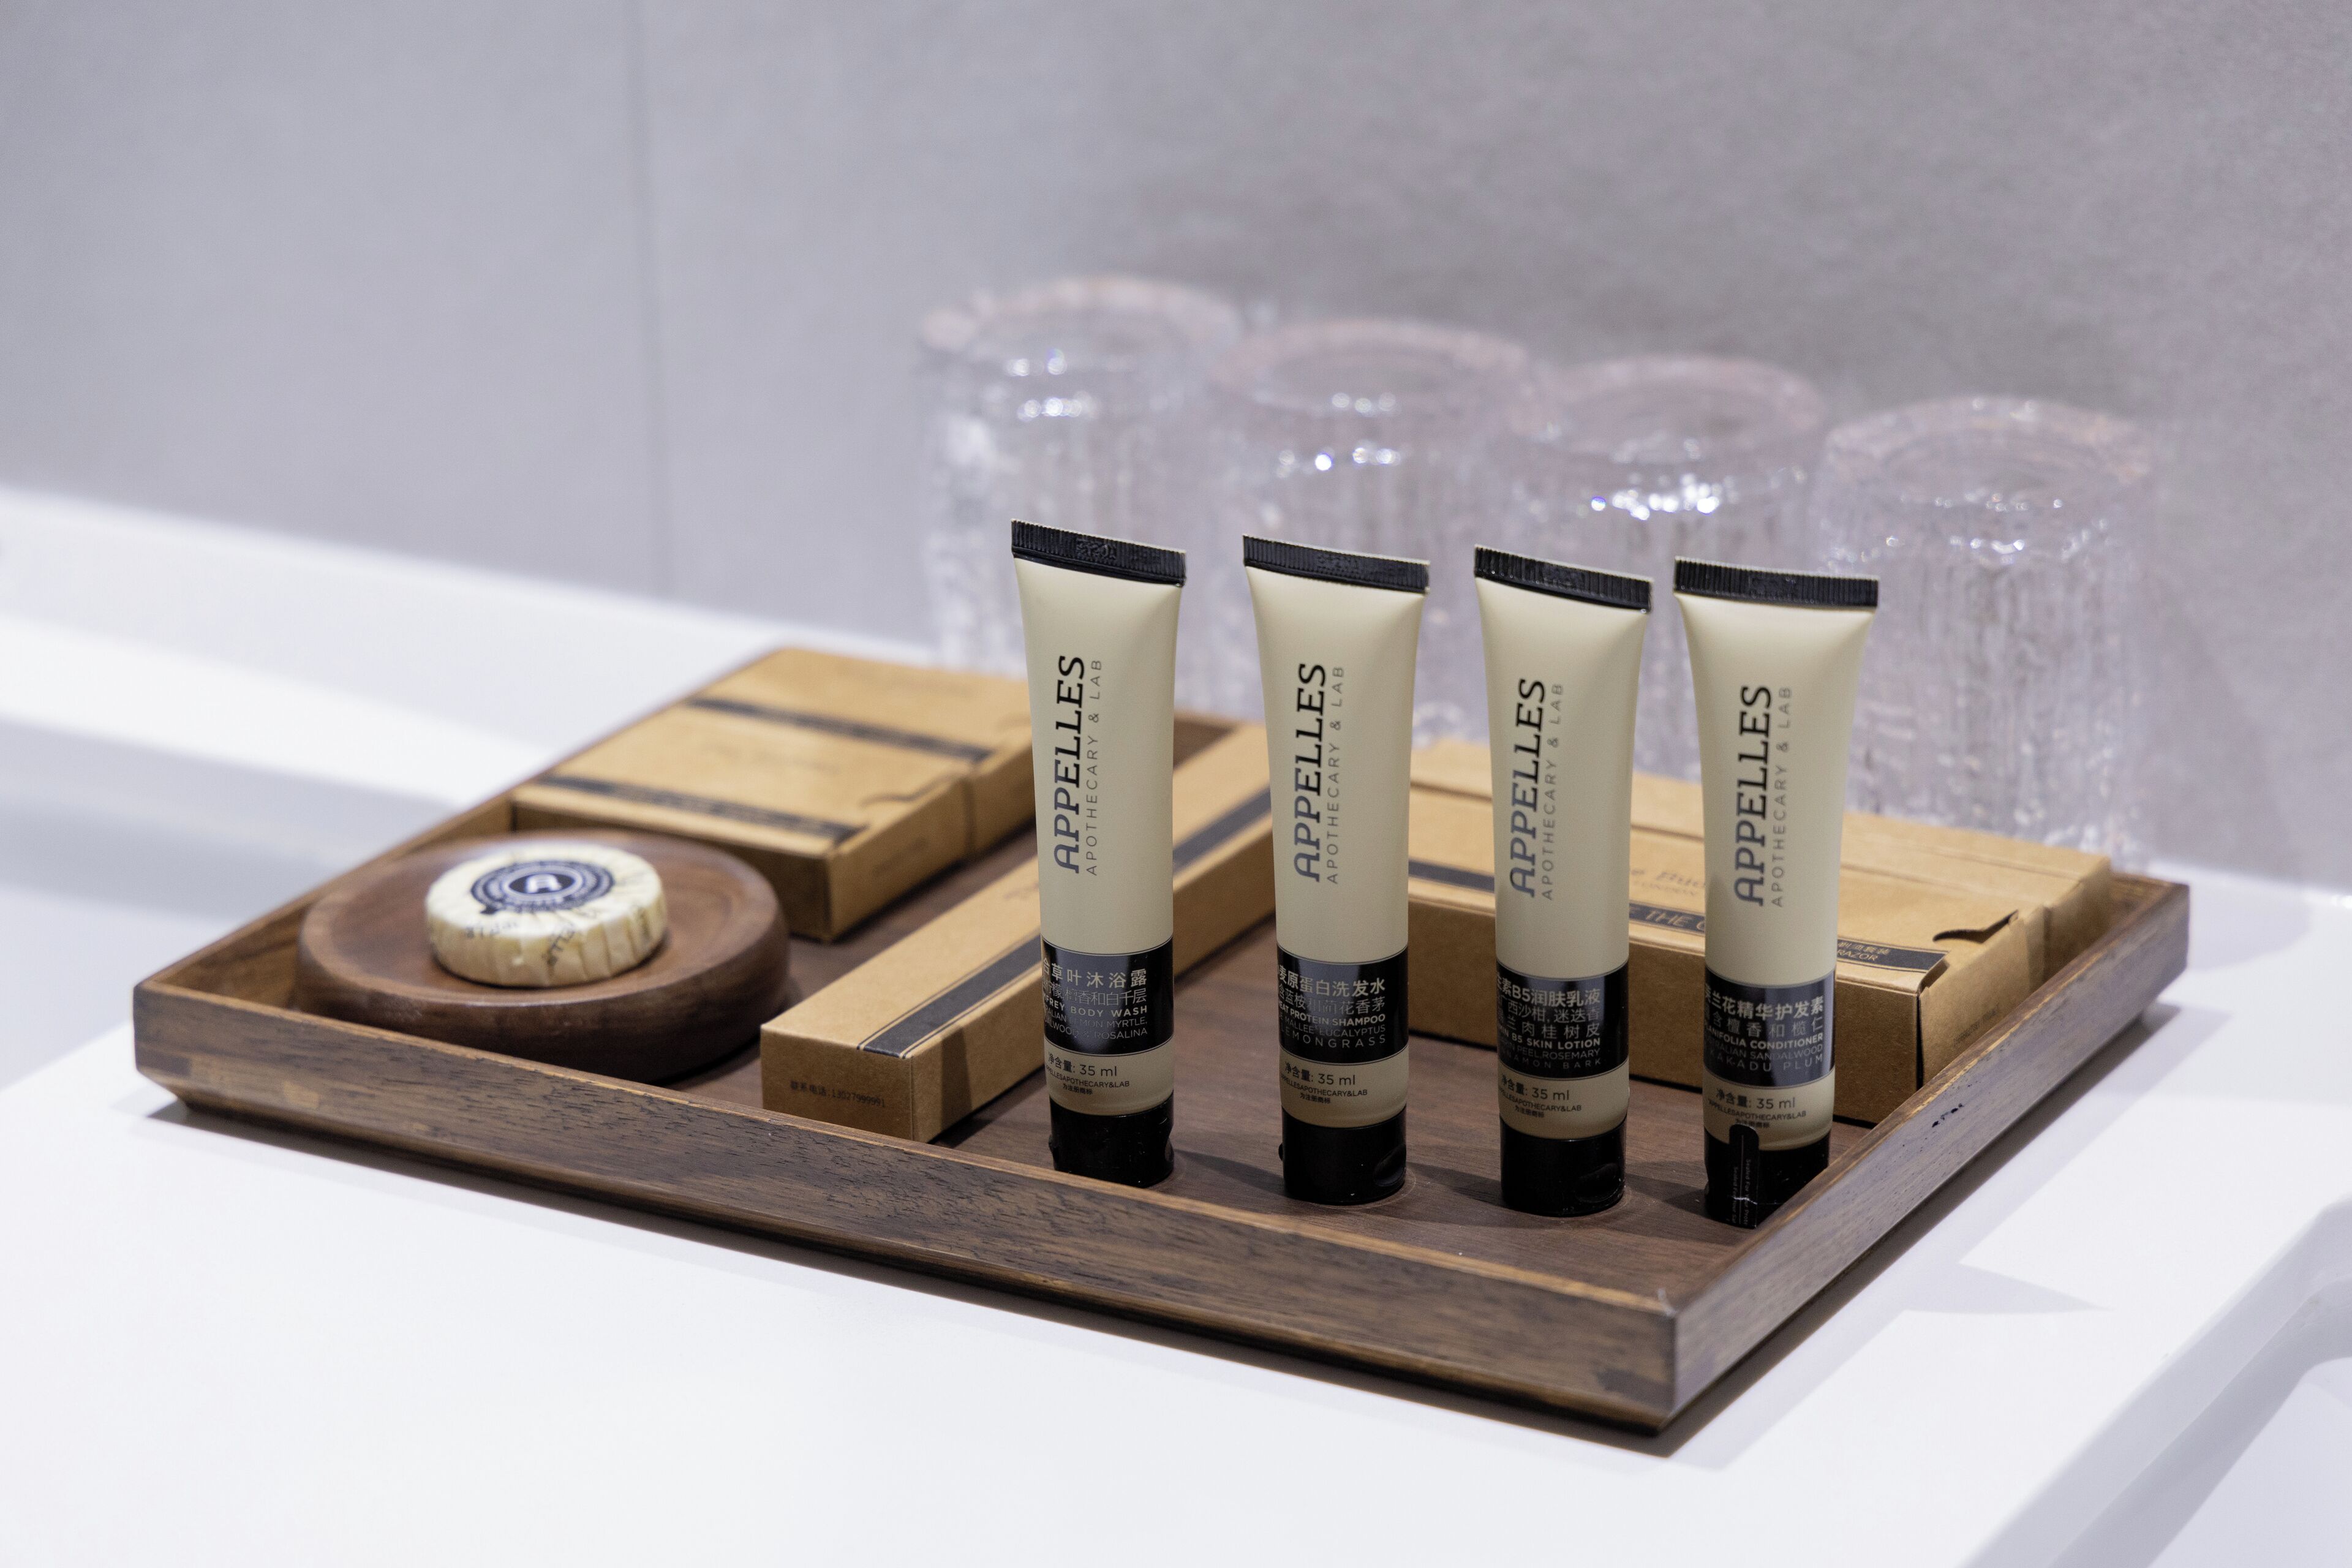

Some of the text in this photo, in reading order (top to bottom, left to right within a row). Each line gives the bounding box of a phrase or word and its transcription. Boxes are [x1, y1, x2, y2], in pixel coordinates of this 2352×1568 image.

[1054, 656, 1085, 873] APPELLES
[1086, 660, 1102, 876] APOTHECARY & LAB
[1294, 663, 1326, 882] APPELLES
[1327, 666, 1344, 884] APOTHECARY & LAB
[1510, 678, 1546, 898] APPELLES
[1542, 684, 1563, 900] APOTHECARY & LAB
[1734, 685, 1771, 907] APPELLES
[1771, 687, 1791, 908] APOTHECARY & LAB
[1646, 910, 1692, 927] THE
[1071, 1006, 1103, 1017] BODY
[1111, 1005, 1147, 1017] WASH
[1291, 1009, 1329, 1025] PROTEIN
[1332, 1014, 1385, 1027] SHAMPOO
[1095, 1028, 1147, 1039] ROSALINA
[1286, 1017, 1314, 1034] MALLEE
[1320, 1024, 1385, 1037] EUCALYPTUS
[1512, 1033, 1523, 1042] B5
[1527, 1038, 1552, 1049] SKIN
[1558, 1038, 1600, 1049] LOTION
[1750, 1033, 1823, 1049] CONDITIONER
[1750, 1044, 1823, 1060] SANDALWOOD
[1563, 1058, 1601, 1069] BARK
[1783, 1054, 1823, 1070] PLUM
[1080, 1065, 1095, 1076] 35
[1101, 1066, 1117, 1076] ml
[1318, 1074, 1334, 1085] 35
[1339, 1075, 1355, 1085] ml
[1532, 1087, 1548, 1099] 35
[1553, 1090, 1569, 1100] ml
[1757, 1098, 1774, 1109] 35
[1779, 1097, 1795, 1108] ml
